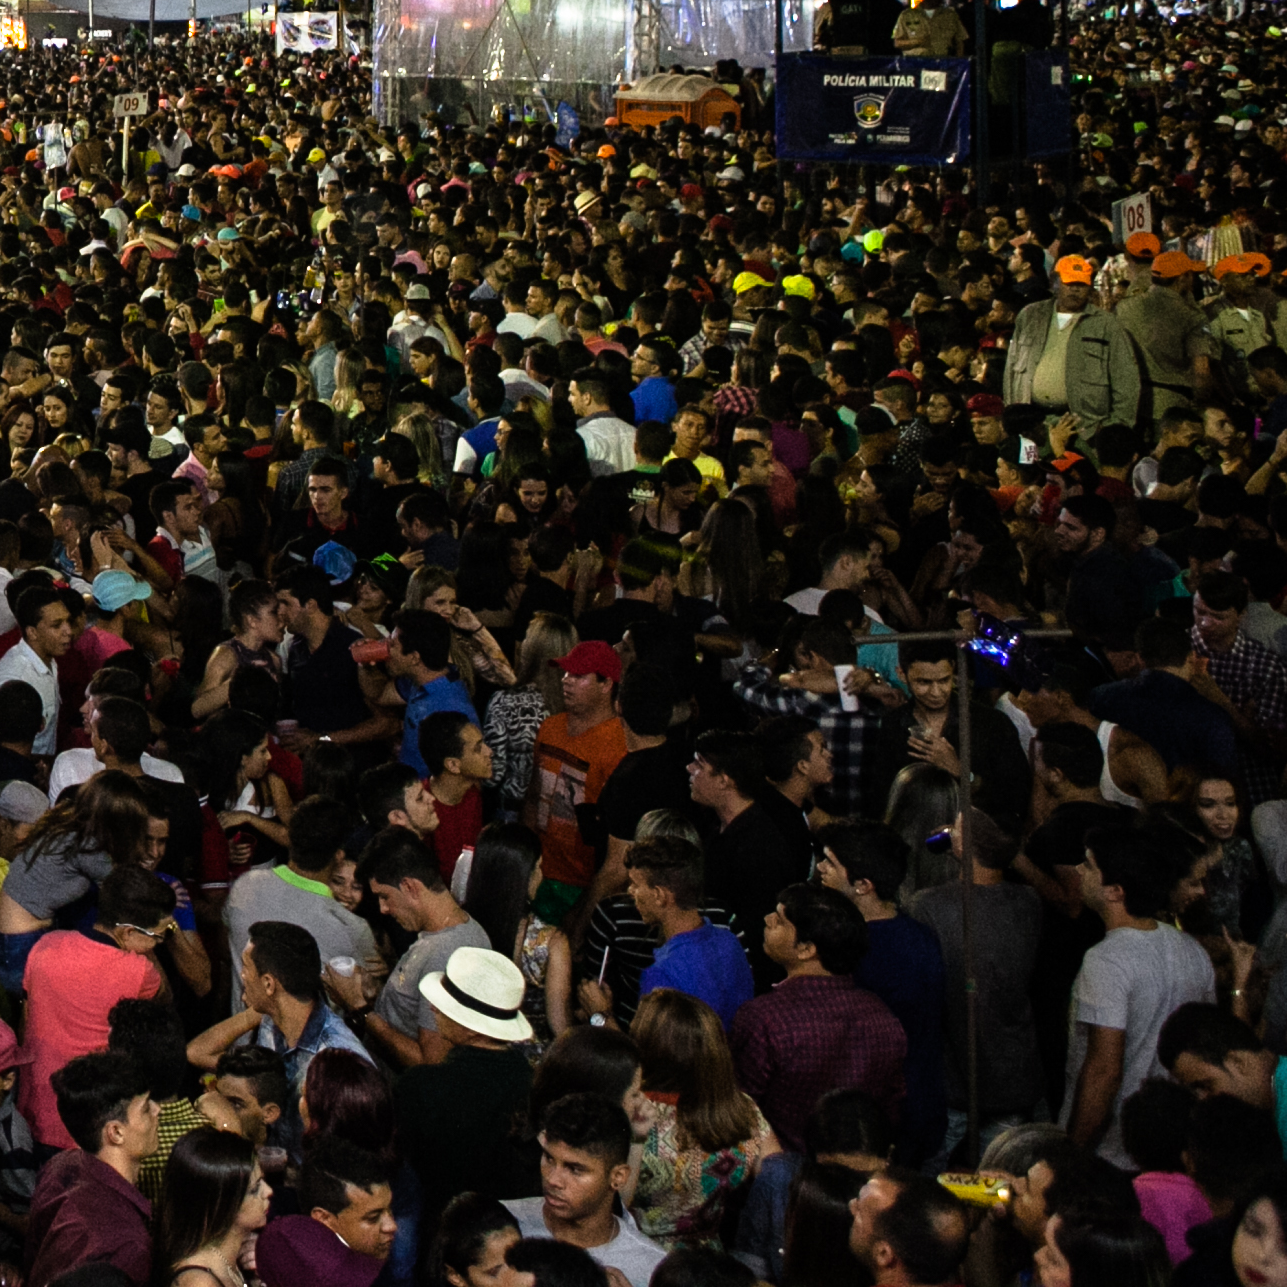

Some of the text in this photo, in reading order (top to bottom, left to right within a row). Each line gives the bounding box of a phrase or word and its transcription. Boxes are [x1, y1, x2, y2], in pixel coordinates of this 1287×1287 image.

[823, 73, 915, 87] POLÍCIA MILITAR
[123, 97, 140, 112] 09
[1126, 203, 1145, 232] 08
